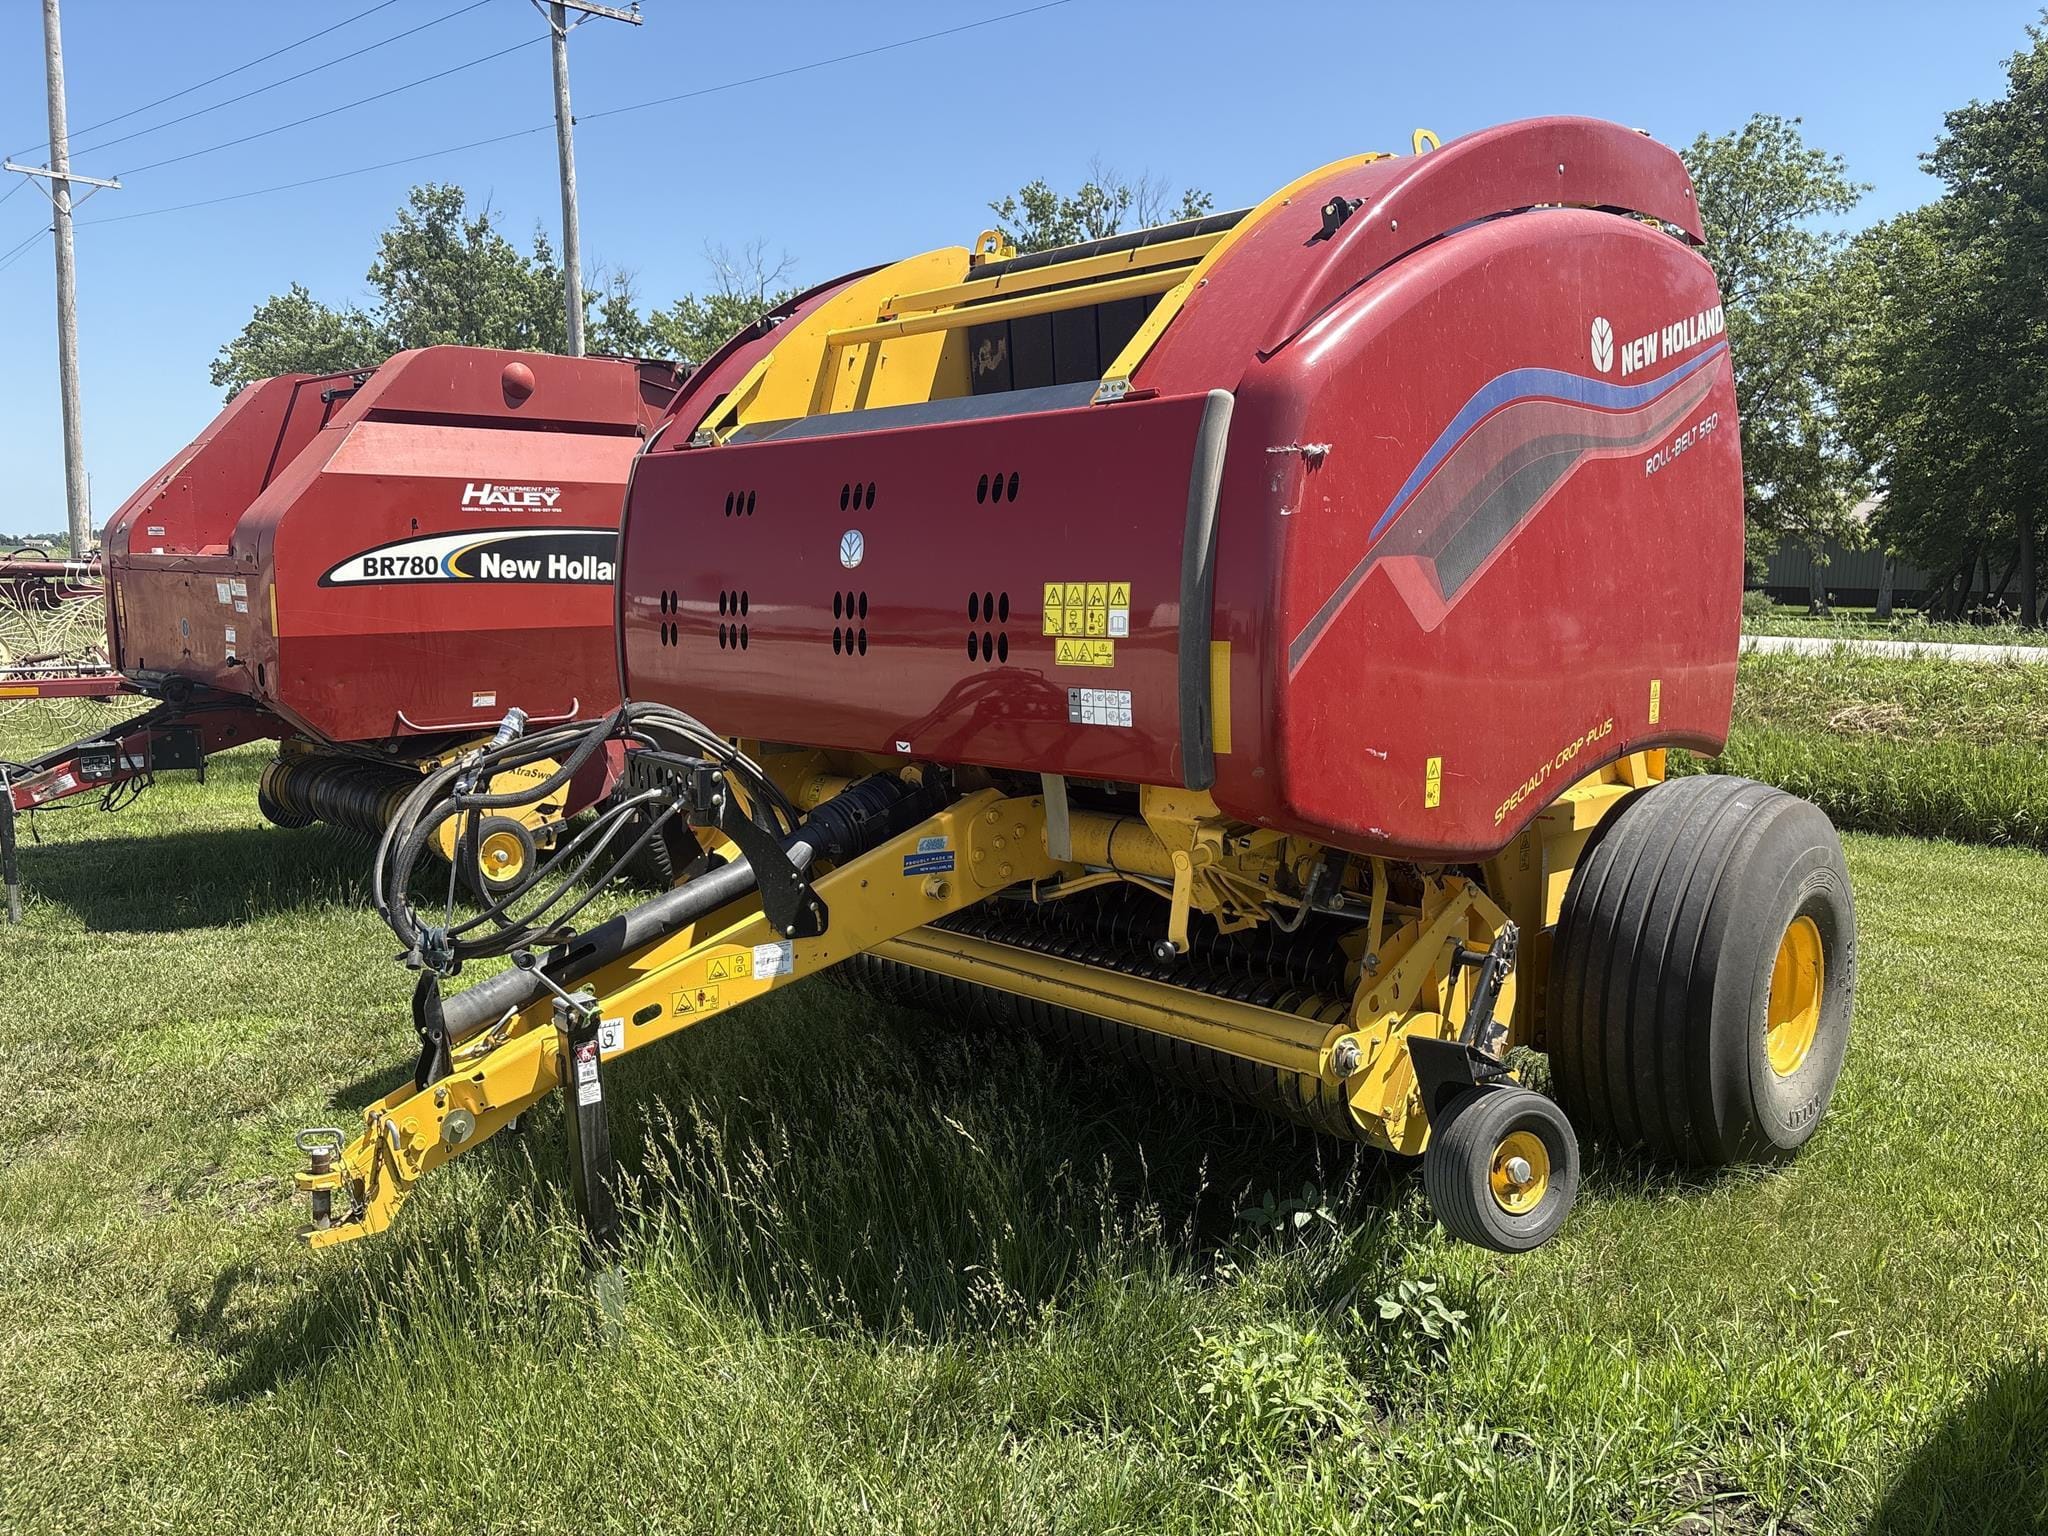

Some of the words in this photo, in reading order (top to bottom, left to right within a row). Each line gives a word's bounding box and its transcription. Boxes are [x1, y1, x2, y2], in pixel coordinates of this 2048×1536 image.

[1621, 331, 1659, 377] NEW
[1661, 304, 1725, 359] HOLLAND
[1645, 425, 1698, 478] ROLL-BELT
[1699, 411, 1718, 440] 560
[461, 483, 561, 506] HALEY
[493, 485, 543, 493] EQUIPMENT
[363, 556, 439, 577] BR780
[479, 552, 542, 579] New
[1494, 759, 1554, 828] SPECIALTY
[1555, 736, 1584, 770] CROP
[1585, 717, 1614, 746] PLUS
